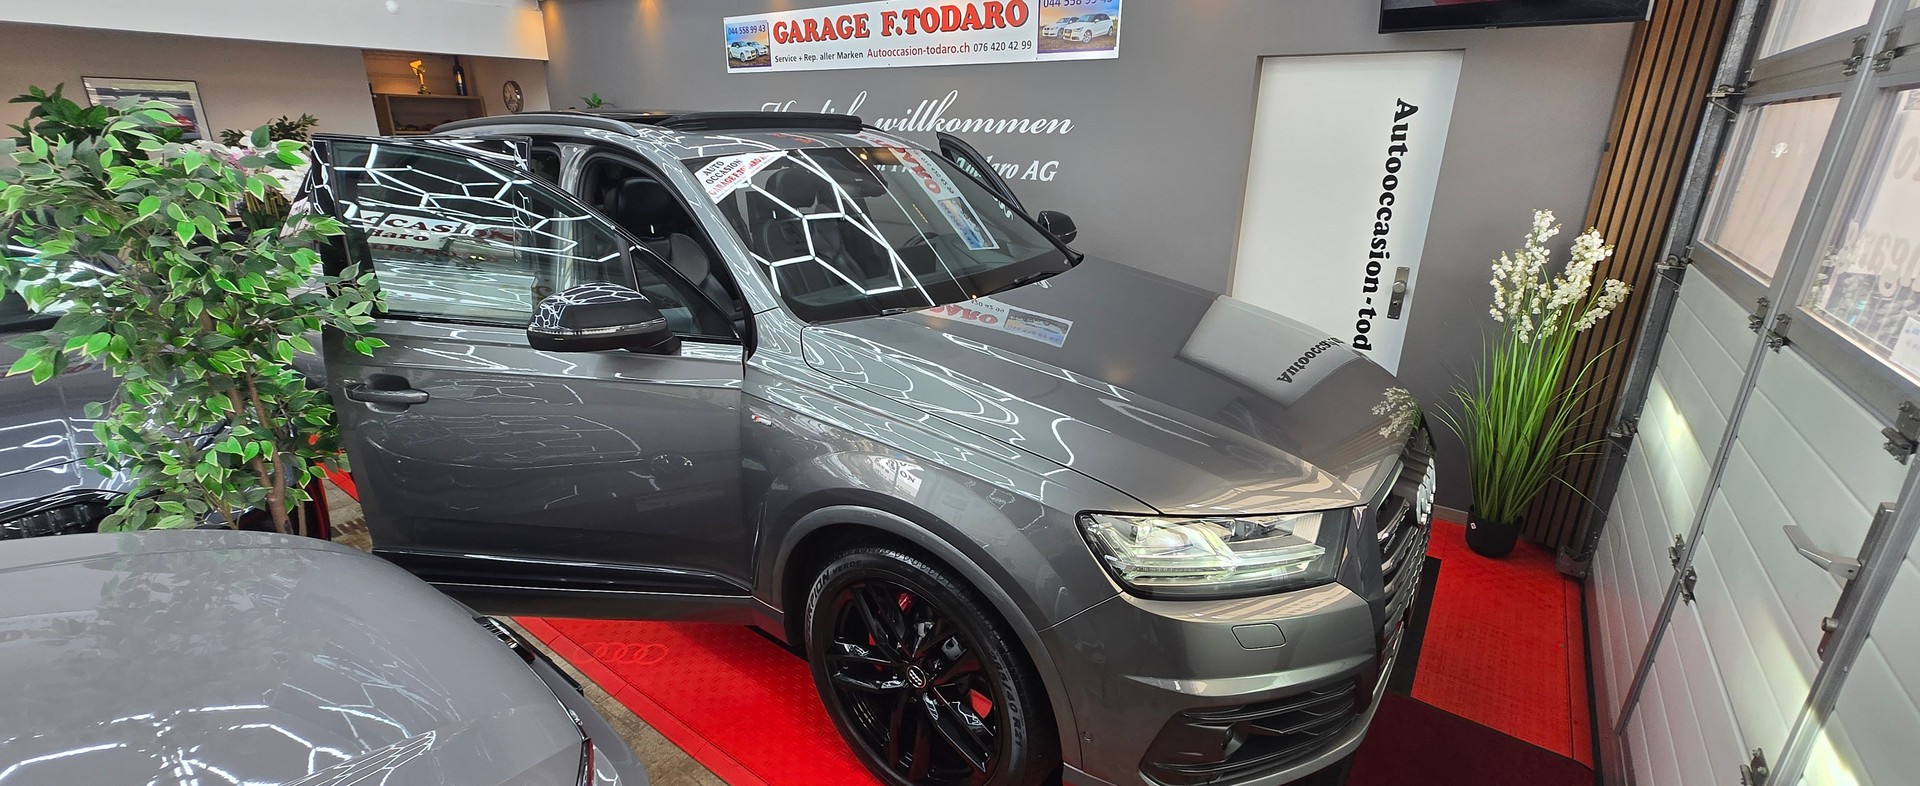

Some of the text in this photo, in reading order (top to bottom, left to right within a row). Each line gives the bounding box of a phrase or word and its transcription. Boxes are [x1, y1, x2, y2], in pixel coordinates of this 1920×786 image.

[728, 24, 766, 35] 044 558 99 43
[773, 0, 1029, 45] GARAGE F.TODARO
[775, 54, 798, 63] Service
[803, 53, 819, 63] Rep.
[820, 52, 836, 61] aller
[837, 50, 864, 60] Marken
[867, 42, 970, 58] Autooccasion-todaro.ch
[973, 42, 989, 52] 076
[990, 41, 1006, 51] 420
[1008, 41, 1019, 51] 42
[1021, 40, 1032, 50] 99
[874, 90, 1075, 135] willkommen
[702, 160, 725, 176] AUTO
[705, 158, 743, 185] OCCASION
[1020, 160, 1060, 182] AG
